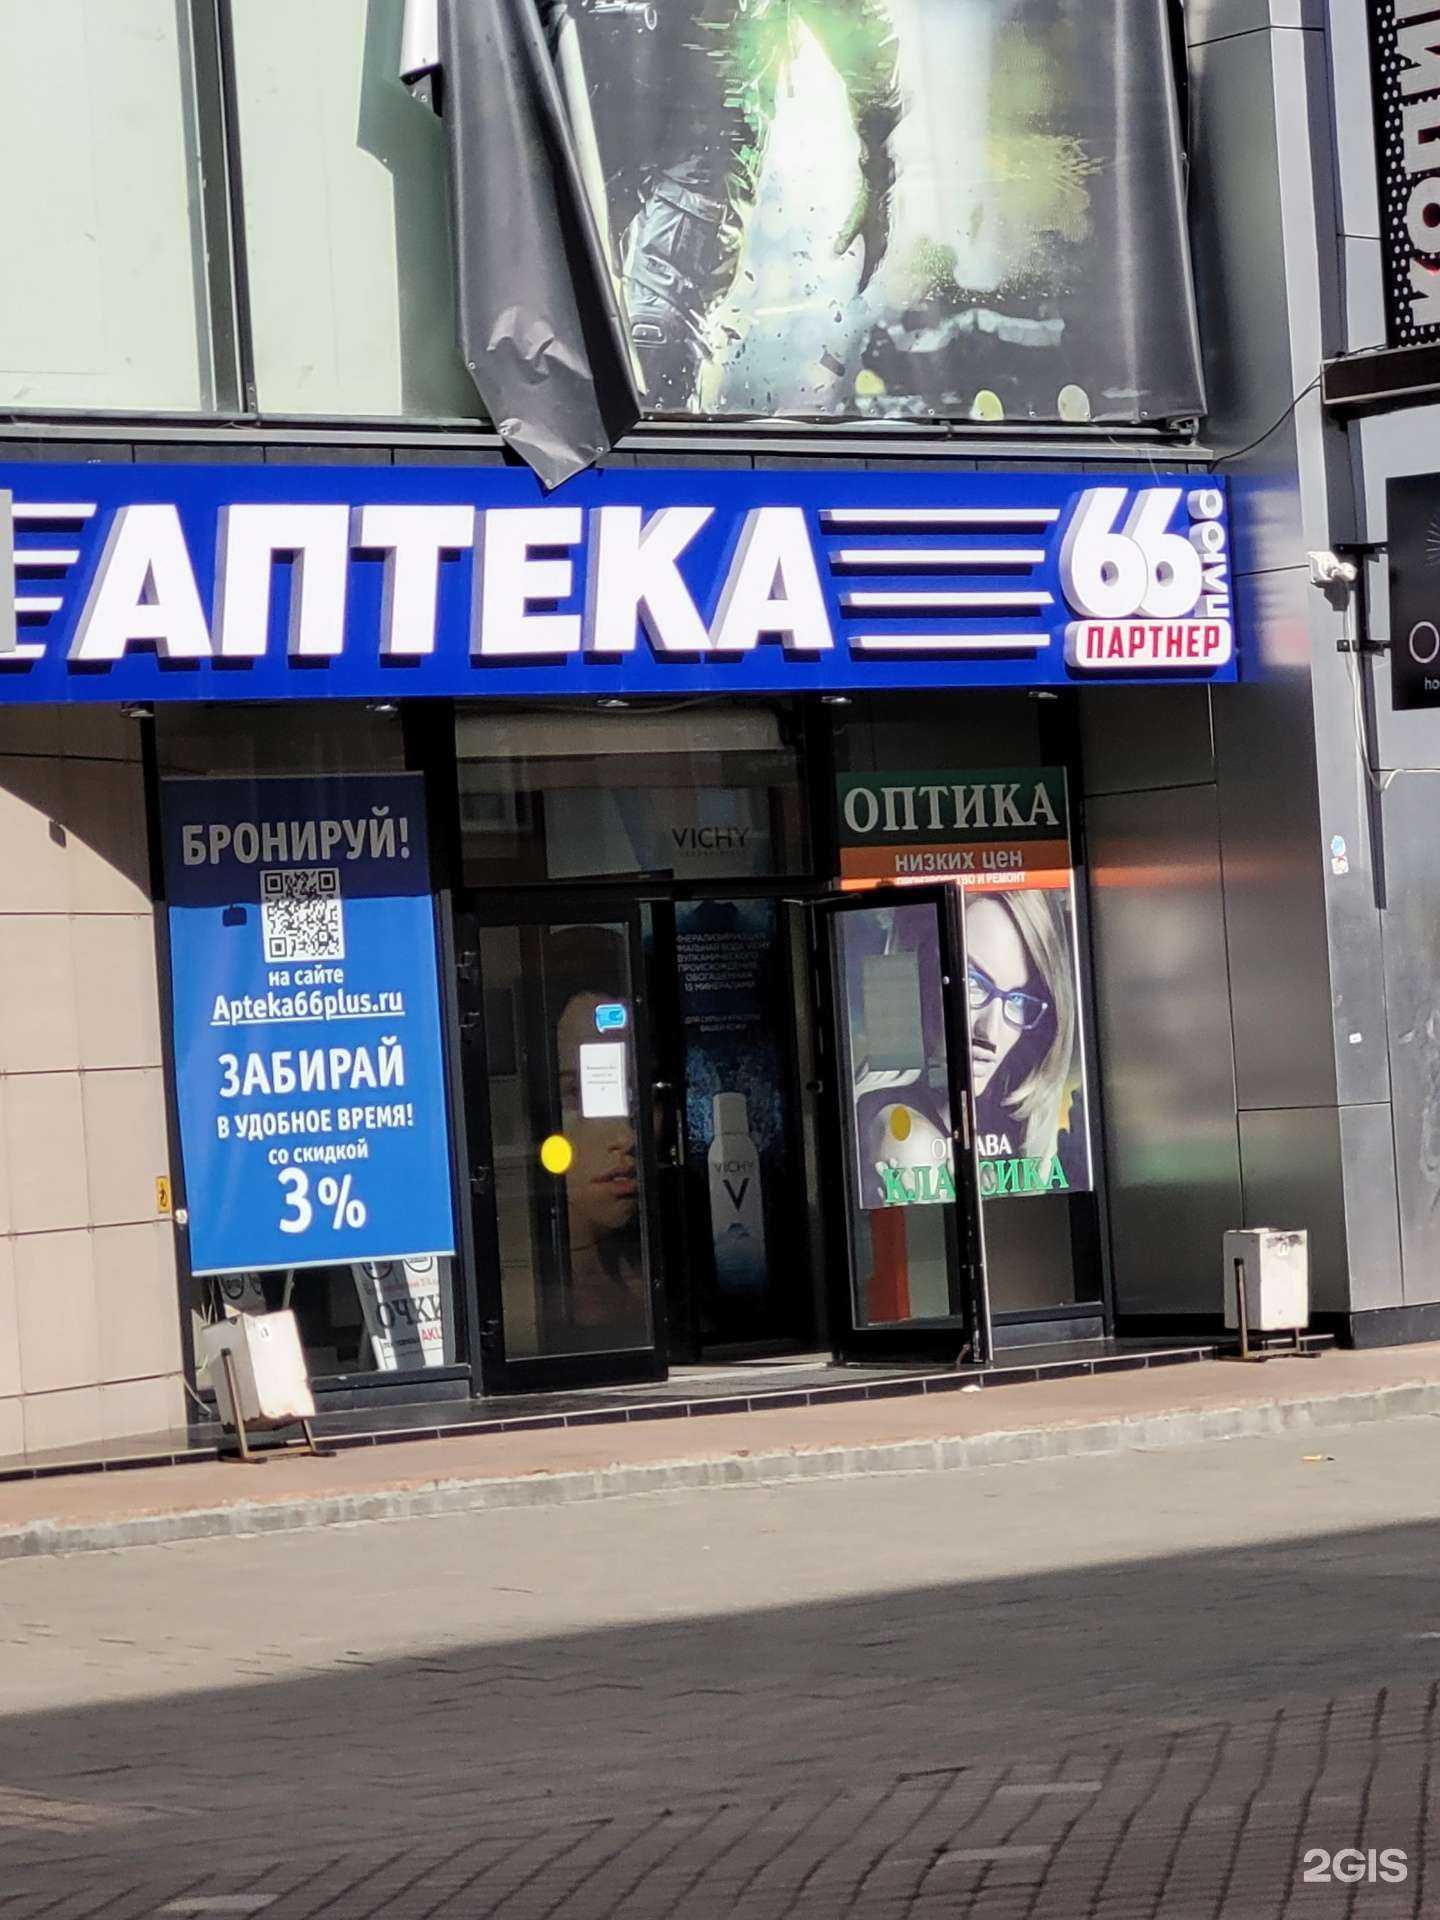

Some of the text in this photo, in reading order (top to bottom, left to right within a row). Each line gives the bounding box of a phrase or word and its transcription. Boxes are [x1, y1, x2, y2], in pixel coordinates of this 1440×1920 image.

[1059, 486, 1202, 618] 66
[1190, 488, 1231, 618] ПЛЮС
[67, 503, 834, 660] АПТЕКА
[1086, 625, 1220, 659] ПАРТНЕР
[844, 782, 1059, 834] ОПТИКА
[182, 805, 410, 866] БРОНИРУЙ!
[672, 826, 750, 849] VICHY
[895, 849, 1023, 872] низких цен
[268, 963, 344, 987] на сайте
[210, 988, 405, 1026] Apteka66plus.ru
[218, 1035, 405, 1098] ЗАБИРАЙ
[217, 1103, 414, 1141] В УДОБНОЕ ВРЕМЯ!
[268, 1137, 369, 1165] со скидкой
[932, 1133, 1012, 1160] ОАВА
[722, 1177, 750, 1212] V
[885, 1154, 1069, 1204] КЛАСИКА
